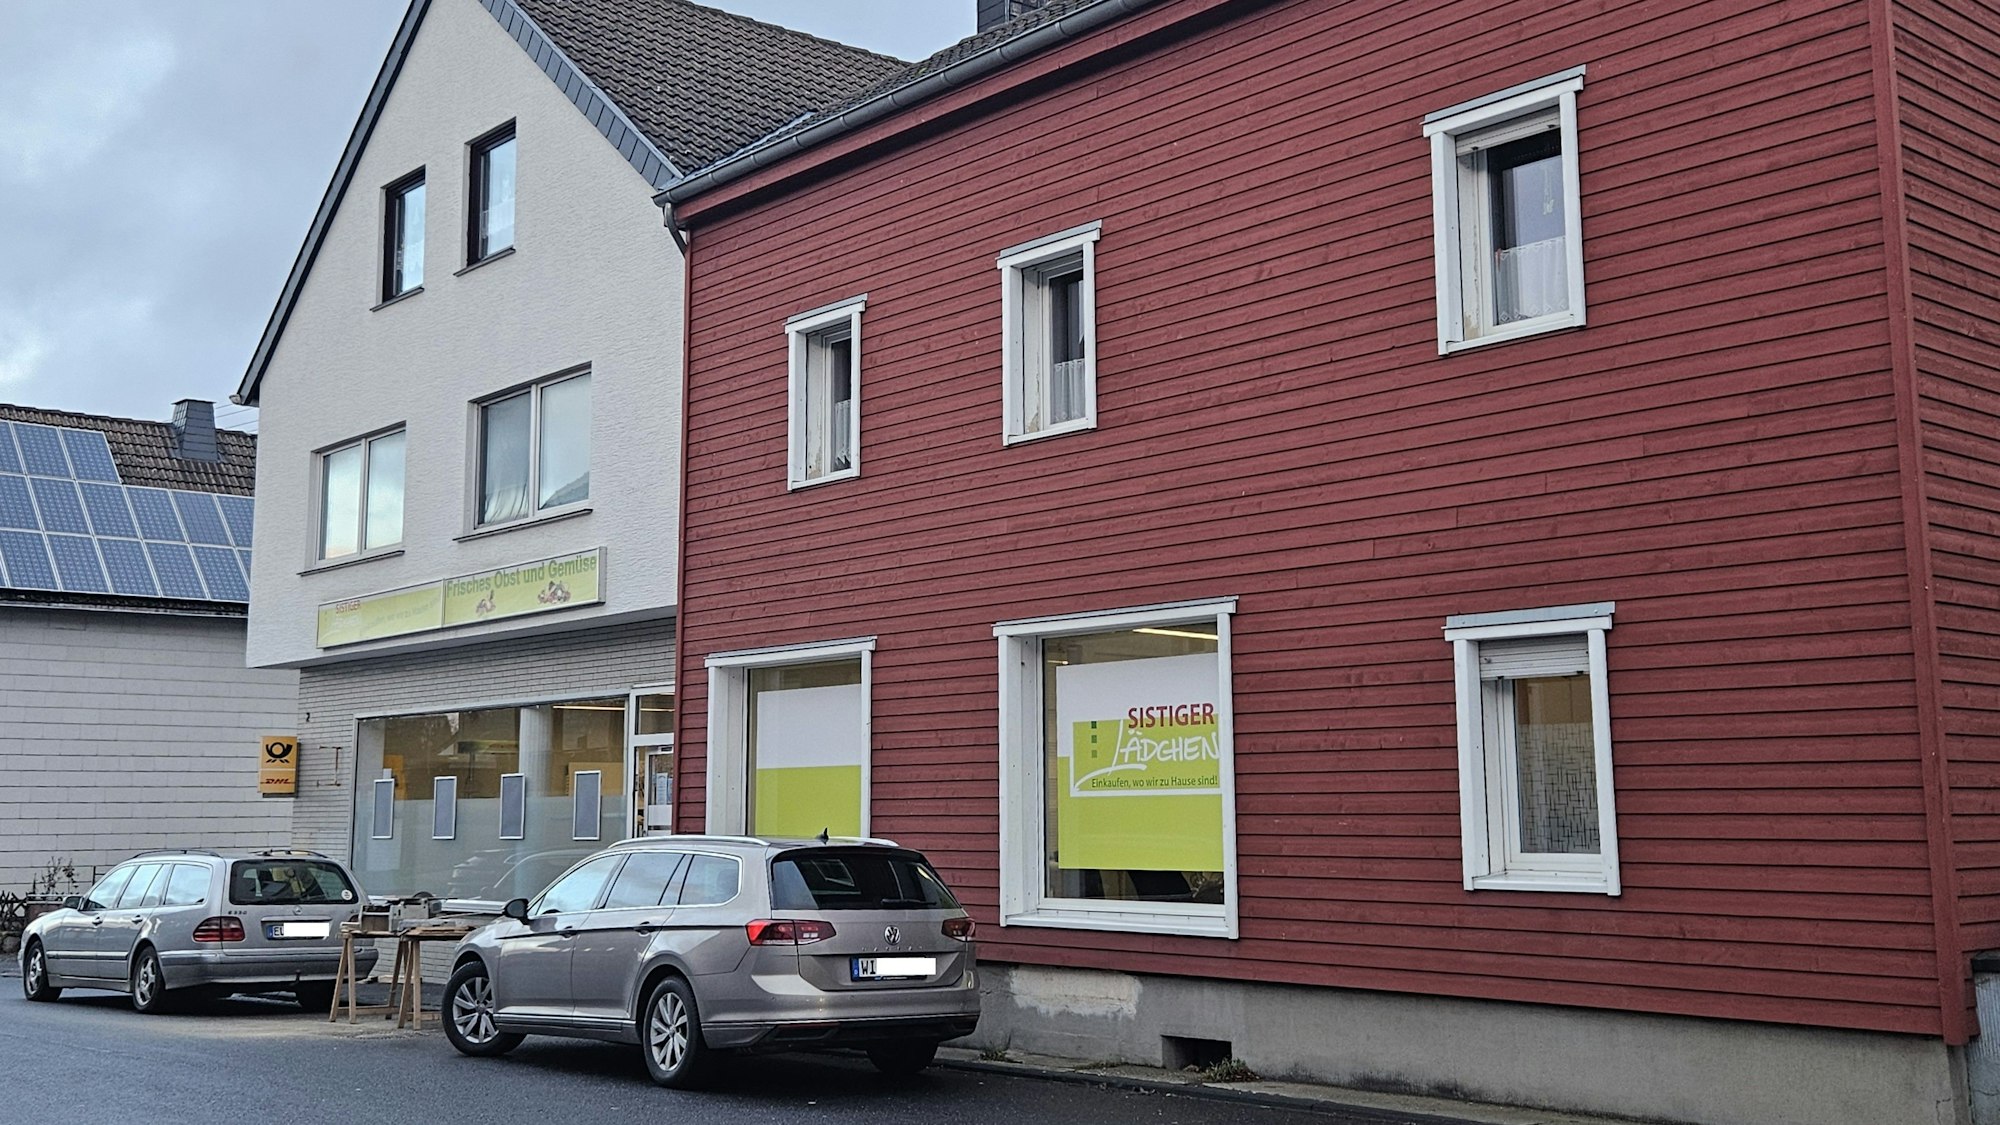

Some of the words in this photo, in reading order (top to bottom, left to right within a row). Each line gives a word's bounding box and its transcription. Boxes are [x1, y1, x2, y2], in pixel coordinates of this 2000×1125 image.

[447, 575, 492, 598] Frisches
[494, 568, 521, 589] Obst
[523, 562, 545, 583] und
[548, 554, 597, 578] Gemüse
[1128, 703, 1215, 729] SISTIGER
[1091, 777, 1131, 788] Einkaufen,
[1132, 779, 1145, 788] wo
[1145, 776, 1159, 787] wir
[1160, 778, 1169, 787] zu
[1170, 776, 1196, 786] Hause
[1197, 775, 1218, 786] sind!
